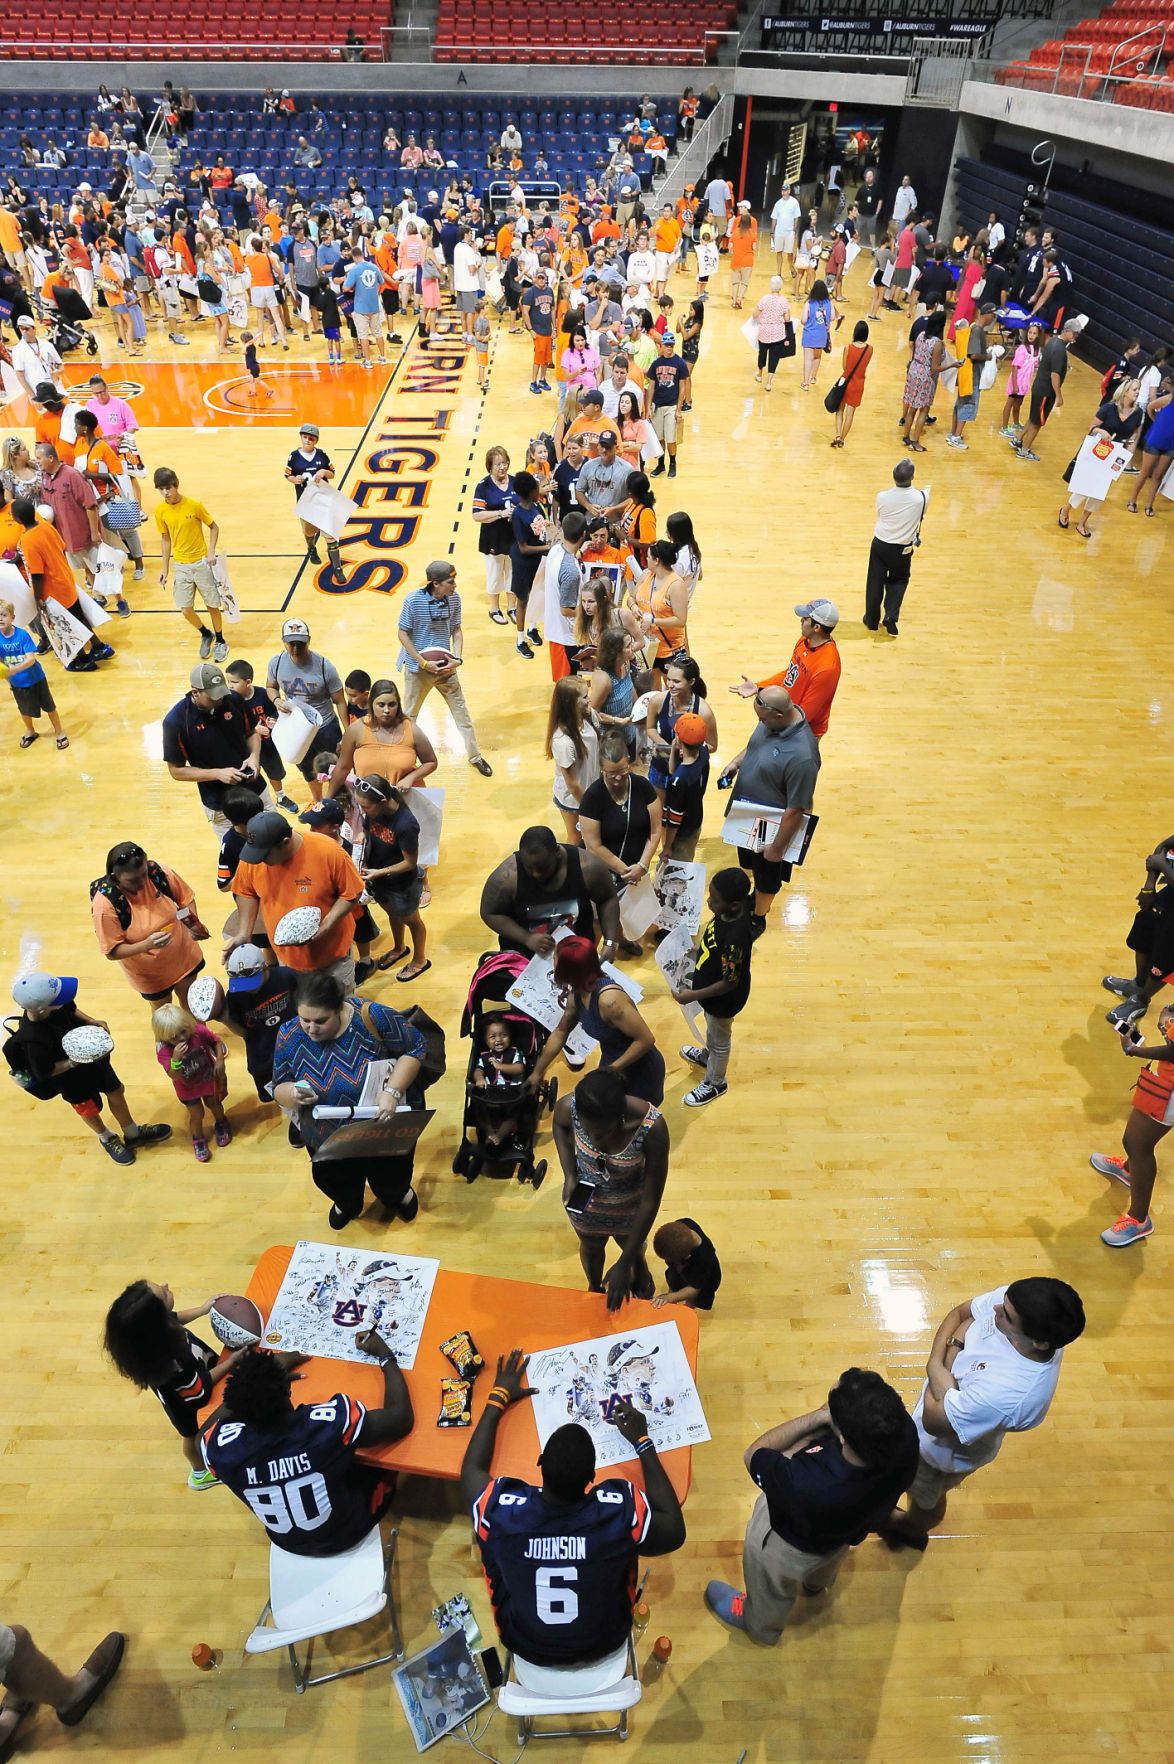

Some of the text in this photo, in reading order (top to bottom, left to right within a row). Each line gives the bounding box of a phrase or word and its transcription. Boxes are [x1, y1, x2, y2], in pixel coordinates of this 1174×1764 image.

[949, 24, 987, 32] #WAREAGLE
[456, 69, 468, 85] A
[1004, 96, 1013, 114] N
[313, 409, 455, 597] TIGERS
[246, 1452, 312, 1485] M. DAVIS
[243, 1471, 333, 1534] 80
[524, 1536, 586, 1560] JOHNSON
[535, 1566, 579, 1625] 6
